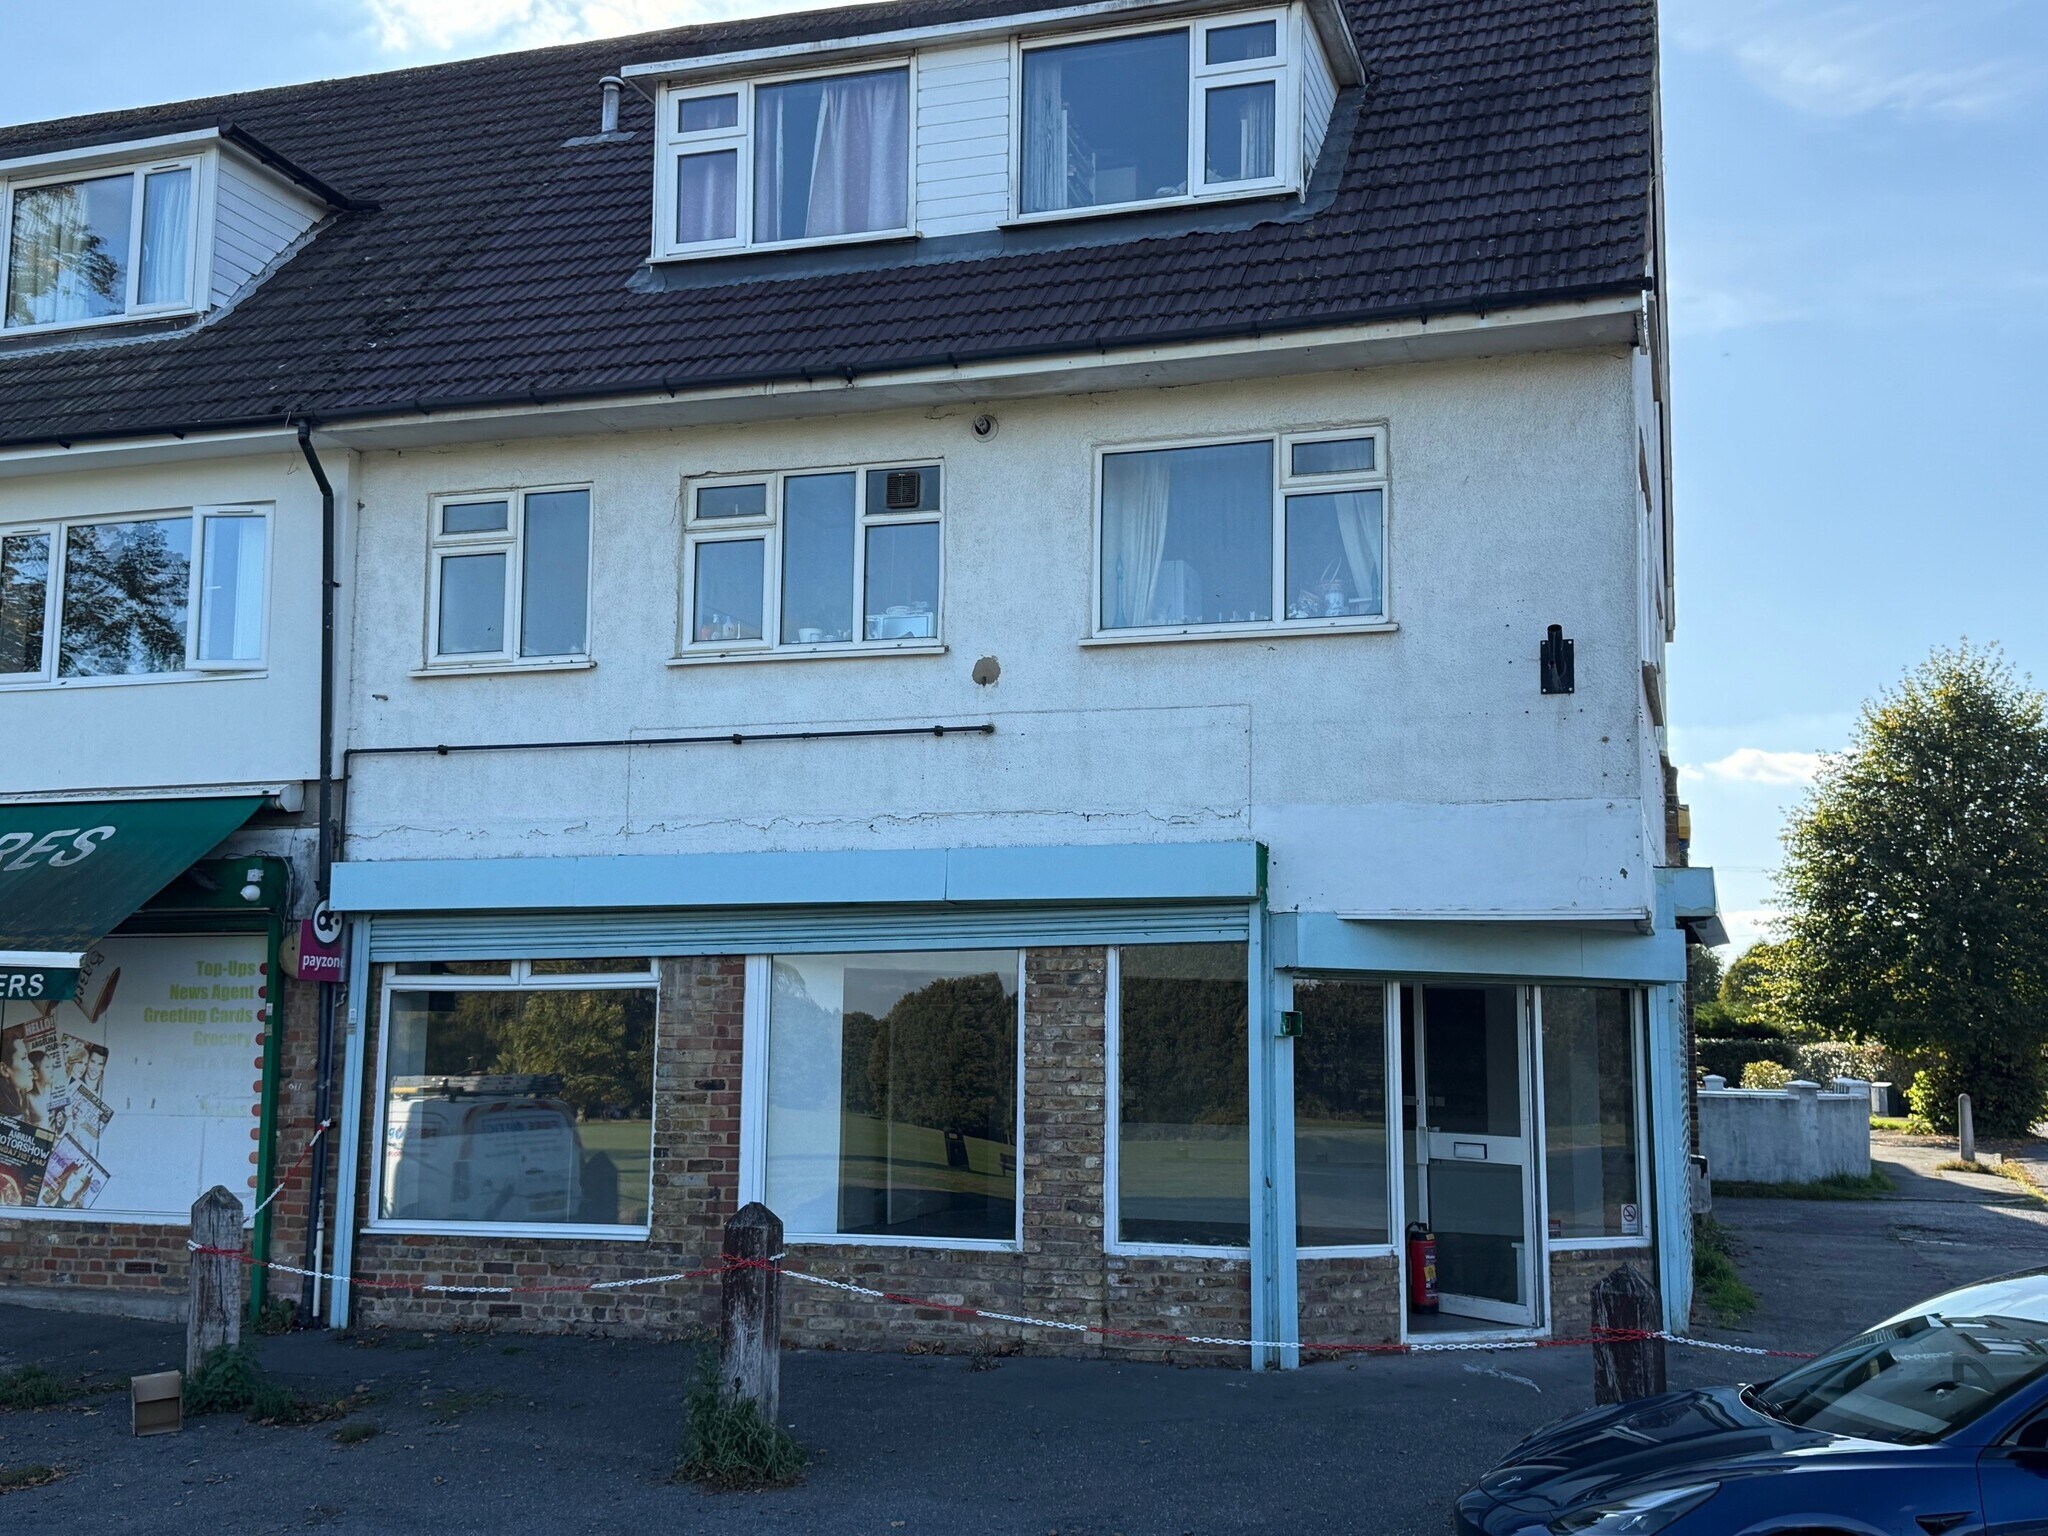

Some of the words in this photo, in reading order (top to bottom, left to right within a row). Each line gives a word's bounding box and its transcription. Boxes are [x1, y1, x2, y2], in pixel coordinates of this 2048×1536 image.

[196, 960, 255, 977] Top-Ups
[169, 983, 208, 999] News
[211, 983, 255, 1001] Agent
[143, 1006, 207, 1024] Greeting
[210, 1007, 253, 1023] Cards
[24, 1017, 55, 1034] HELLO!
[0, 1134, 50, 1159] OTORSHOW
[8, 1130, 36, 1146] ANNUAL
